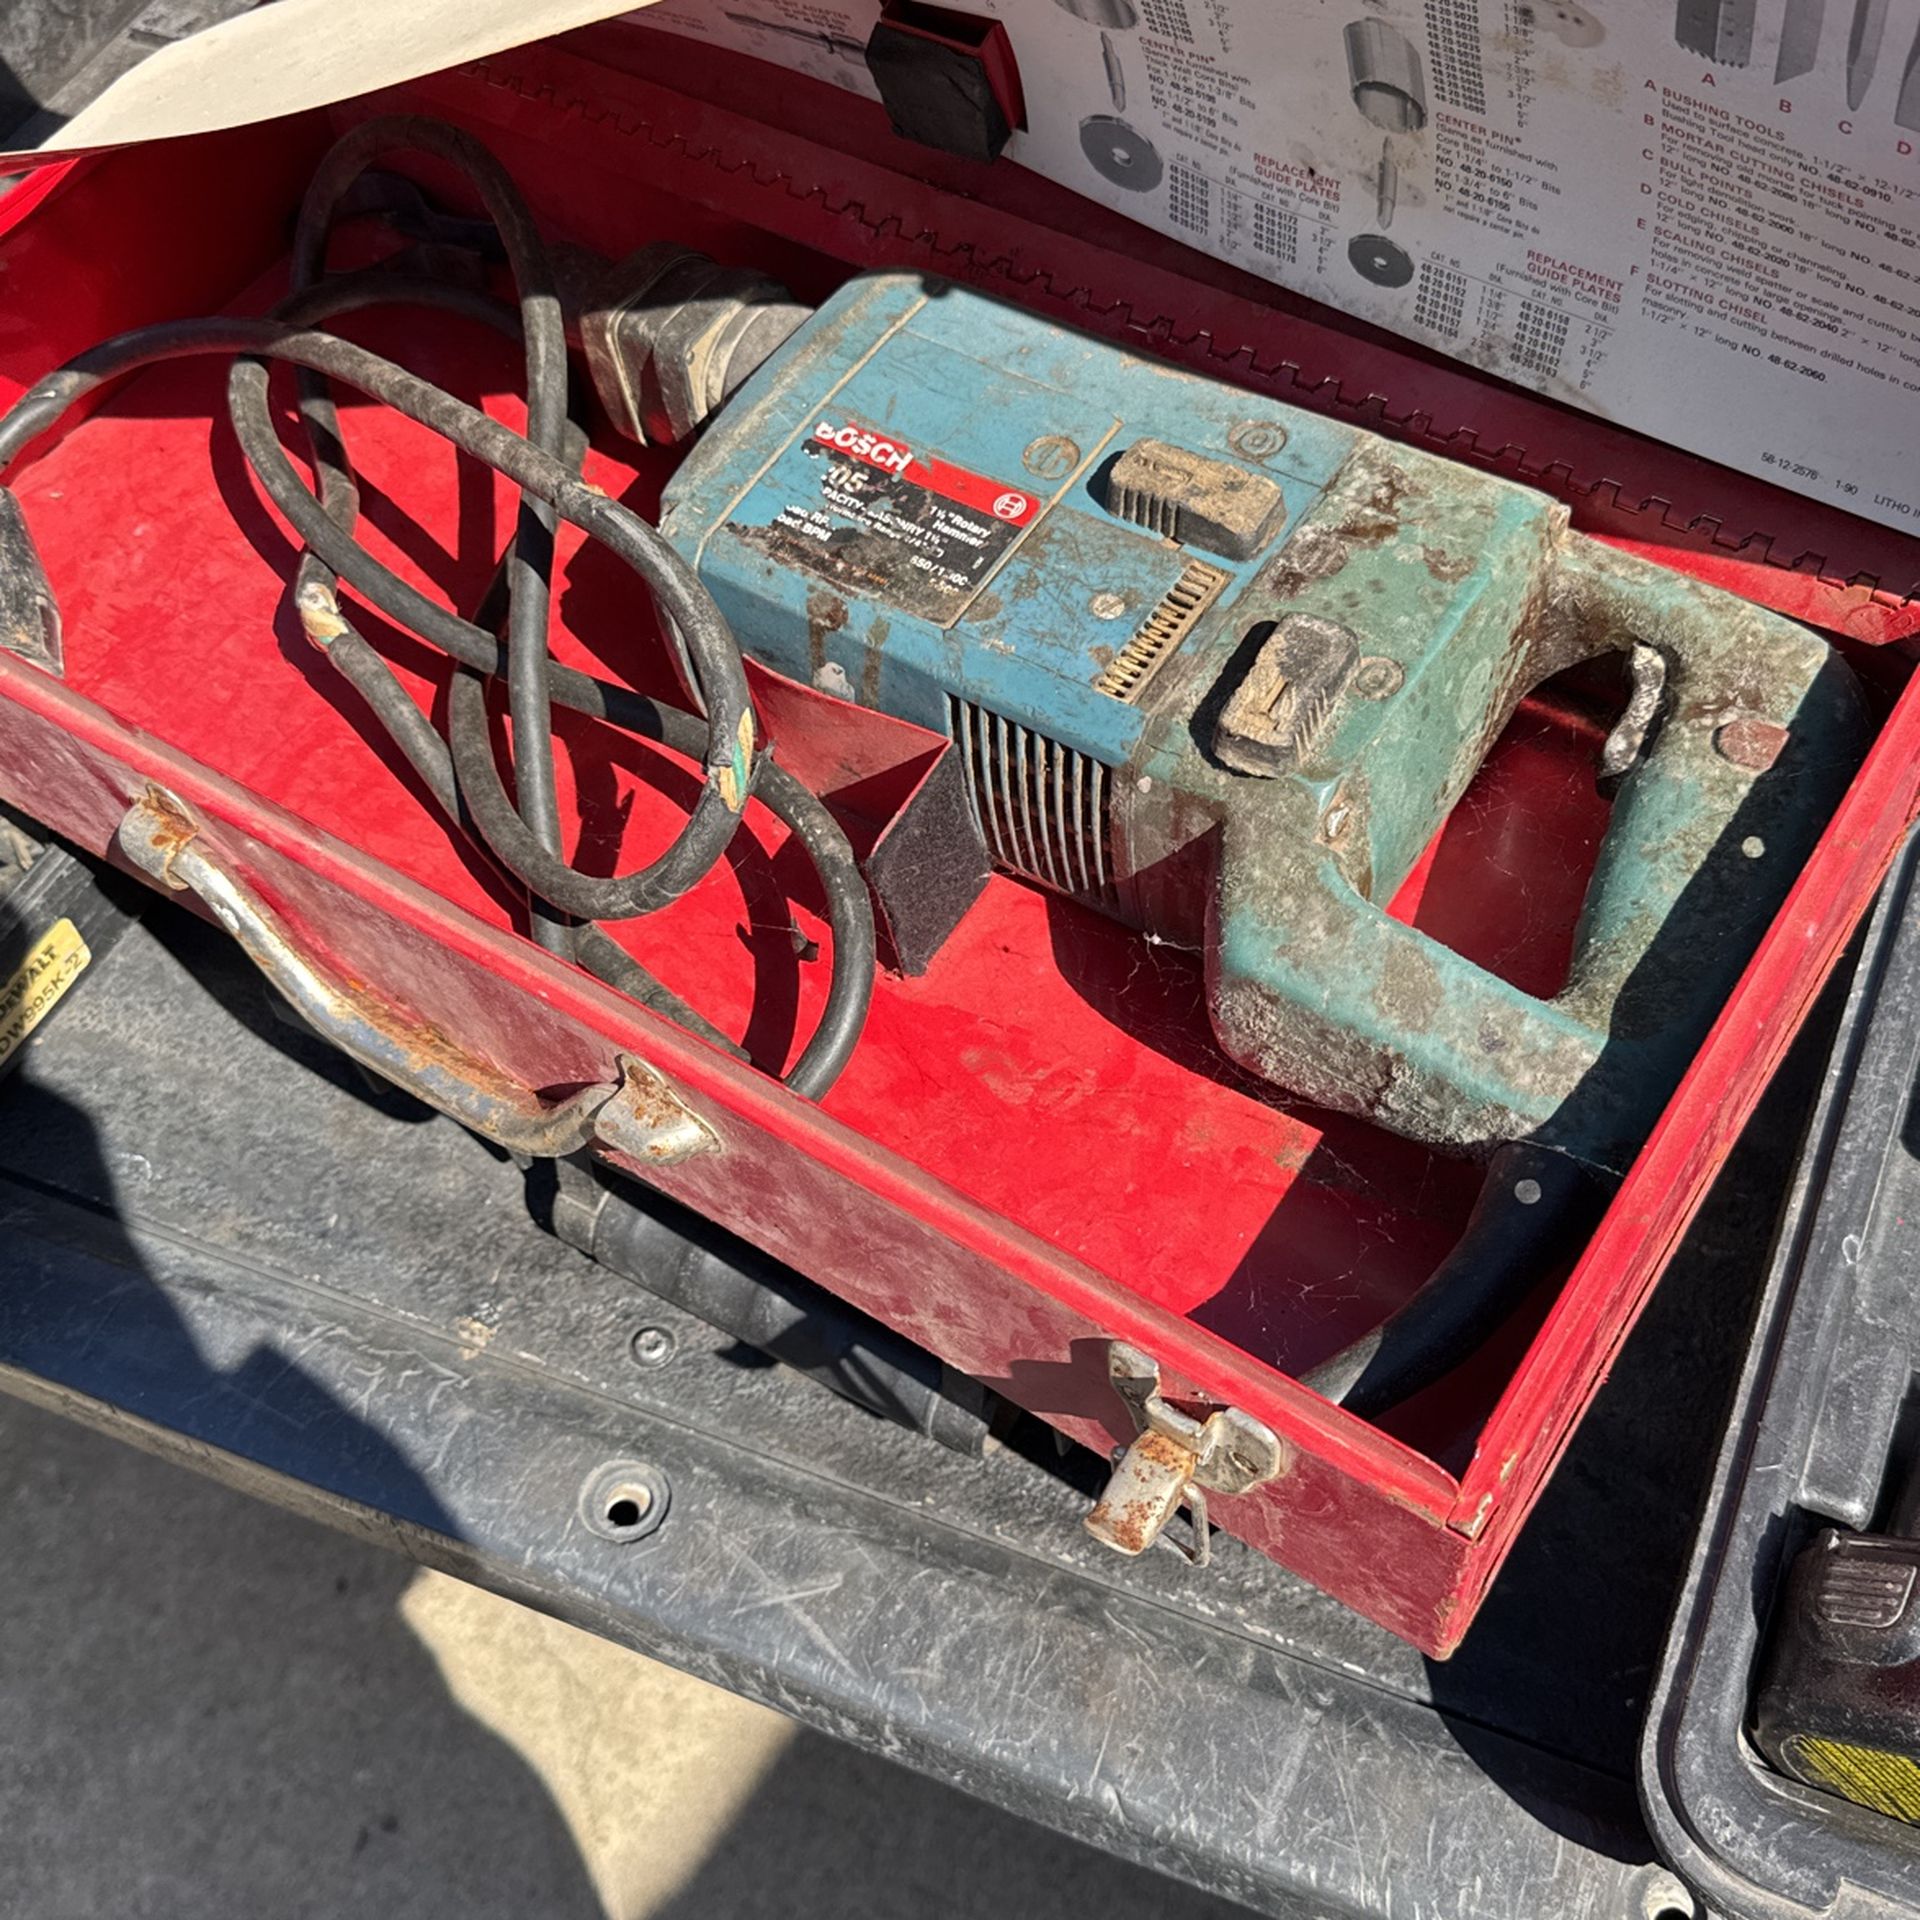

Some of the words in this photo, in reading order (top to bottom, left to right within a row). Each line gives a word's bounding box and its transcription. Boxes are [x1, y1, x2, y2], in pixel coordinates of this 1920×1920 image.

[1701, 73, 1716, 87] A
[1435, 111, 1486, 136] CENTER
[1644, 79, 1656, 92] A
[1662, 86, 1729, 121] BUSHING
[1735, 115, 1784, 142] TOOLS
[1662, 97, 1689, 115] Used
[1693, 111, 1704, 121] to
[1708, 117, 1748, 138] surface
[1779, 99, 1792, 113] B
[1838, 120, 1853, 135] C
[1435, 132, 1459, 147] Core
[1485, 139, 1532, 163] furnished
[1535, 158, 1558, 171] with
[1662, 107, 1705, 134] Bushing
[1710, 126, 1733, 143] Tool
[1738, 138, 1765, 156] head
[1769, 152, 1794, 167] only
[1896, 141, 1912, 155] D
[1254, 164, 1290, 186] GUIDE
[1295, 175, 1340, 200] PLATES
[1642, 148, 1653, 161] C
[1660, 156, 1694, 177] BULL
[1700, 172, 1752, 199] POINTS
[1644, 113, 1654, 126] B
[1661, 122, 1724, 154] MORTAR
[1730, 149, 1794, 182] CUTTING
[1800, 177, 1864, 208] CHISELS
[1659, 166, 1677, 179] For
[1681, 174, 1703, 190] light
[1707, 186, 1764, 213] demolition
[1661, 132, 1678, 145] For
[1682, 142, 1732, 169] removing
[1736, 164, 1753, 175] old
[1757, 172, 1794, 191] mortar
[1799, 187, 1815, 198] for
[1819, 195, 1842, 210] tuck
[1848, 207, 1895, 232] pointing
[1900, 227, 1912, 235] or
[1682, 151, 1706, 169] long
[1825, 207, 1850, 225] long
[1640, 182, 1651, 195] D
[1657, 190, 1694, 211] COLD
[1700, 206, 1759, 236] CHISELS
[1656, 200, 1673, 213] For
[1721, 226, 1767, 250] chipping
[1771, 245, 1782, 253] or
[1680, 185, 1704, 202] long
[1821, 239, 1846, 257] long
[1527, 249, 1623, 291] REPLACEMENT
[1636, 217, 1645, 229] E
[1654, 225, 1714, 255] SCALING
[1720, 250, 1779, 279] CHISELS
[1677, 219, 1701, 236] long
[1816, 271, 1840, 289] long
[1496, 262, 1546, 288] (Furnished
[1550, 284, 1570, 296] with
[1574, 290, 1598, 307] Core
[1527, 261, 1567, 284] GUIDE
[1571, 277, 1621, 303] PLATES
[1631, 264, 1639, 276] F
[1646, 272, 1713, 304] SLOTTING
[1718, 299, 1767, 324] CHISEL
[1651, 247, 1678, 263] holes
[1681, 259, 1691, 267] in
[1694, 264, 1740, 286] concrete
[1744, 281, 1759, 292] for
[1762, 288, 1789, 304] large
[1653, 235, 1669, 248] For
[1673, 245, 1722, 270] removing
[1726, 265, 1751, 279] weld
[1755, 275, 1792, 293] spatter
[1796, 290, 1807, 299] or
[1812, 296, 1838, 311] scale
[1842, 308, 1864, 321] and
[1867, 317, 1906, 339] cutting
[1725, 285, 1748, 302] long
[1645, 283, 1661, 296] For
[1665, 292, 1703, 314] slotting
[1706, 308, 1727, 321] and
[1730, 316, 1766, 337] cutting
[1771, 330, 1816, 354] between
[1820, 349, 1853, 367] drilled
[1856, 361, 1885, 380] holes
[1889, 375, 1899, 385] in
[1715, 333, 1738, 351] long
[1835, 479, 1858, 496] 1-90
[1873, 493, 1910, 514] LITHO
[801, 520, 831, 541] BPM
[932, 521, 983, 547] Hammer
